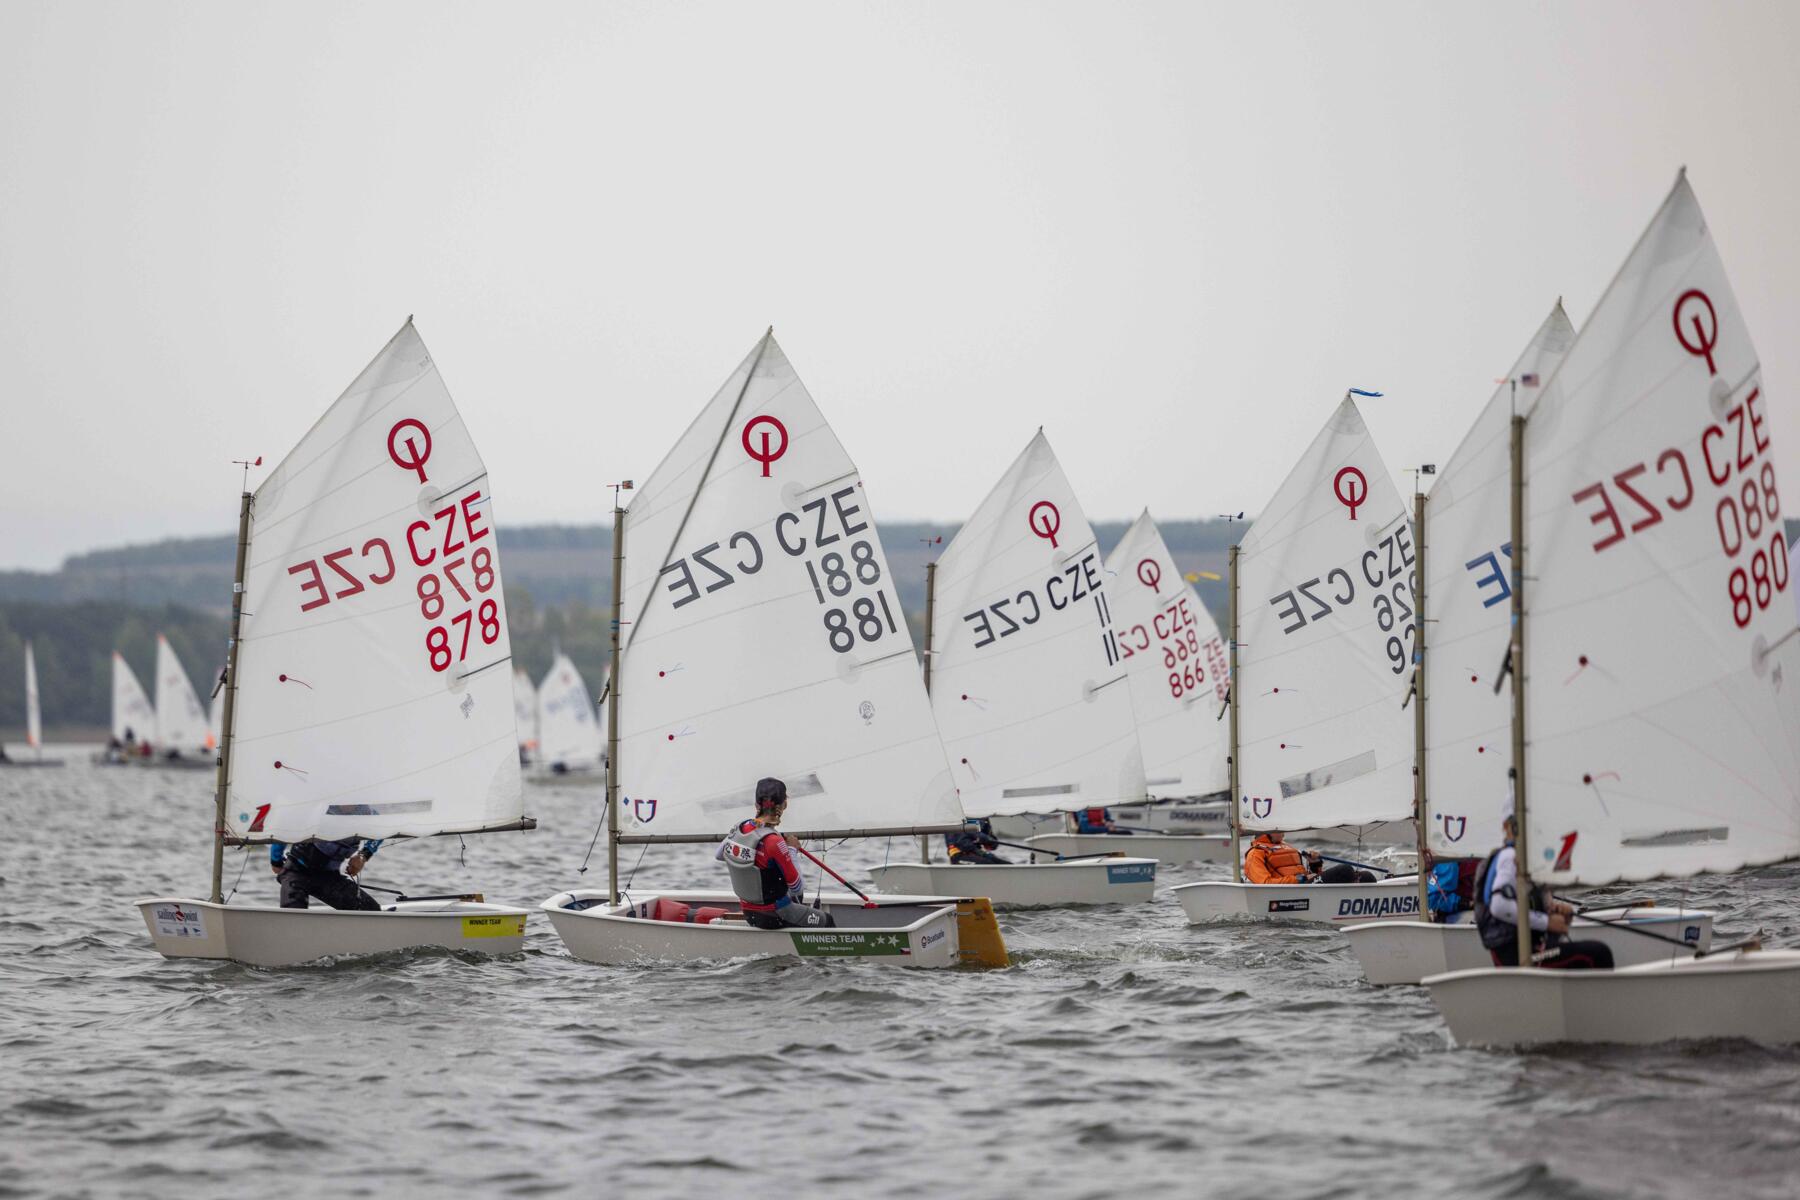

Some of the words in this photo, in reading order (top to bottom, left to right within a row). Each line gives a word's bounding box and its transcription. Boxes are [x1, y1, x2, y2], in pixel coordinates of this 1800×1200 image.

[1701, 386, 1770, 486] CZE
[406, 490, 489, 567] CZE
[775, 486, 868, 556] CZE
[1046, 553, 1102, 611] CZE
[1362, 524, 1416, 588] CZE
[1728, 531, 1788, 629] 880
[426, 599, 500, 672] 878
[823, 590, 897, 653] 881
[1102, 630, 1119, 666] 11
[1153, 598, 1192, 639] CZE
[1169, 658, 1204, 698] 866
[801, 935, 838, 943] WINNER
[838, 934, 865, 943] TEAM
